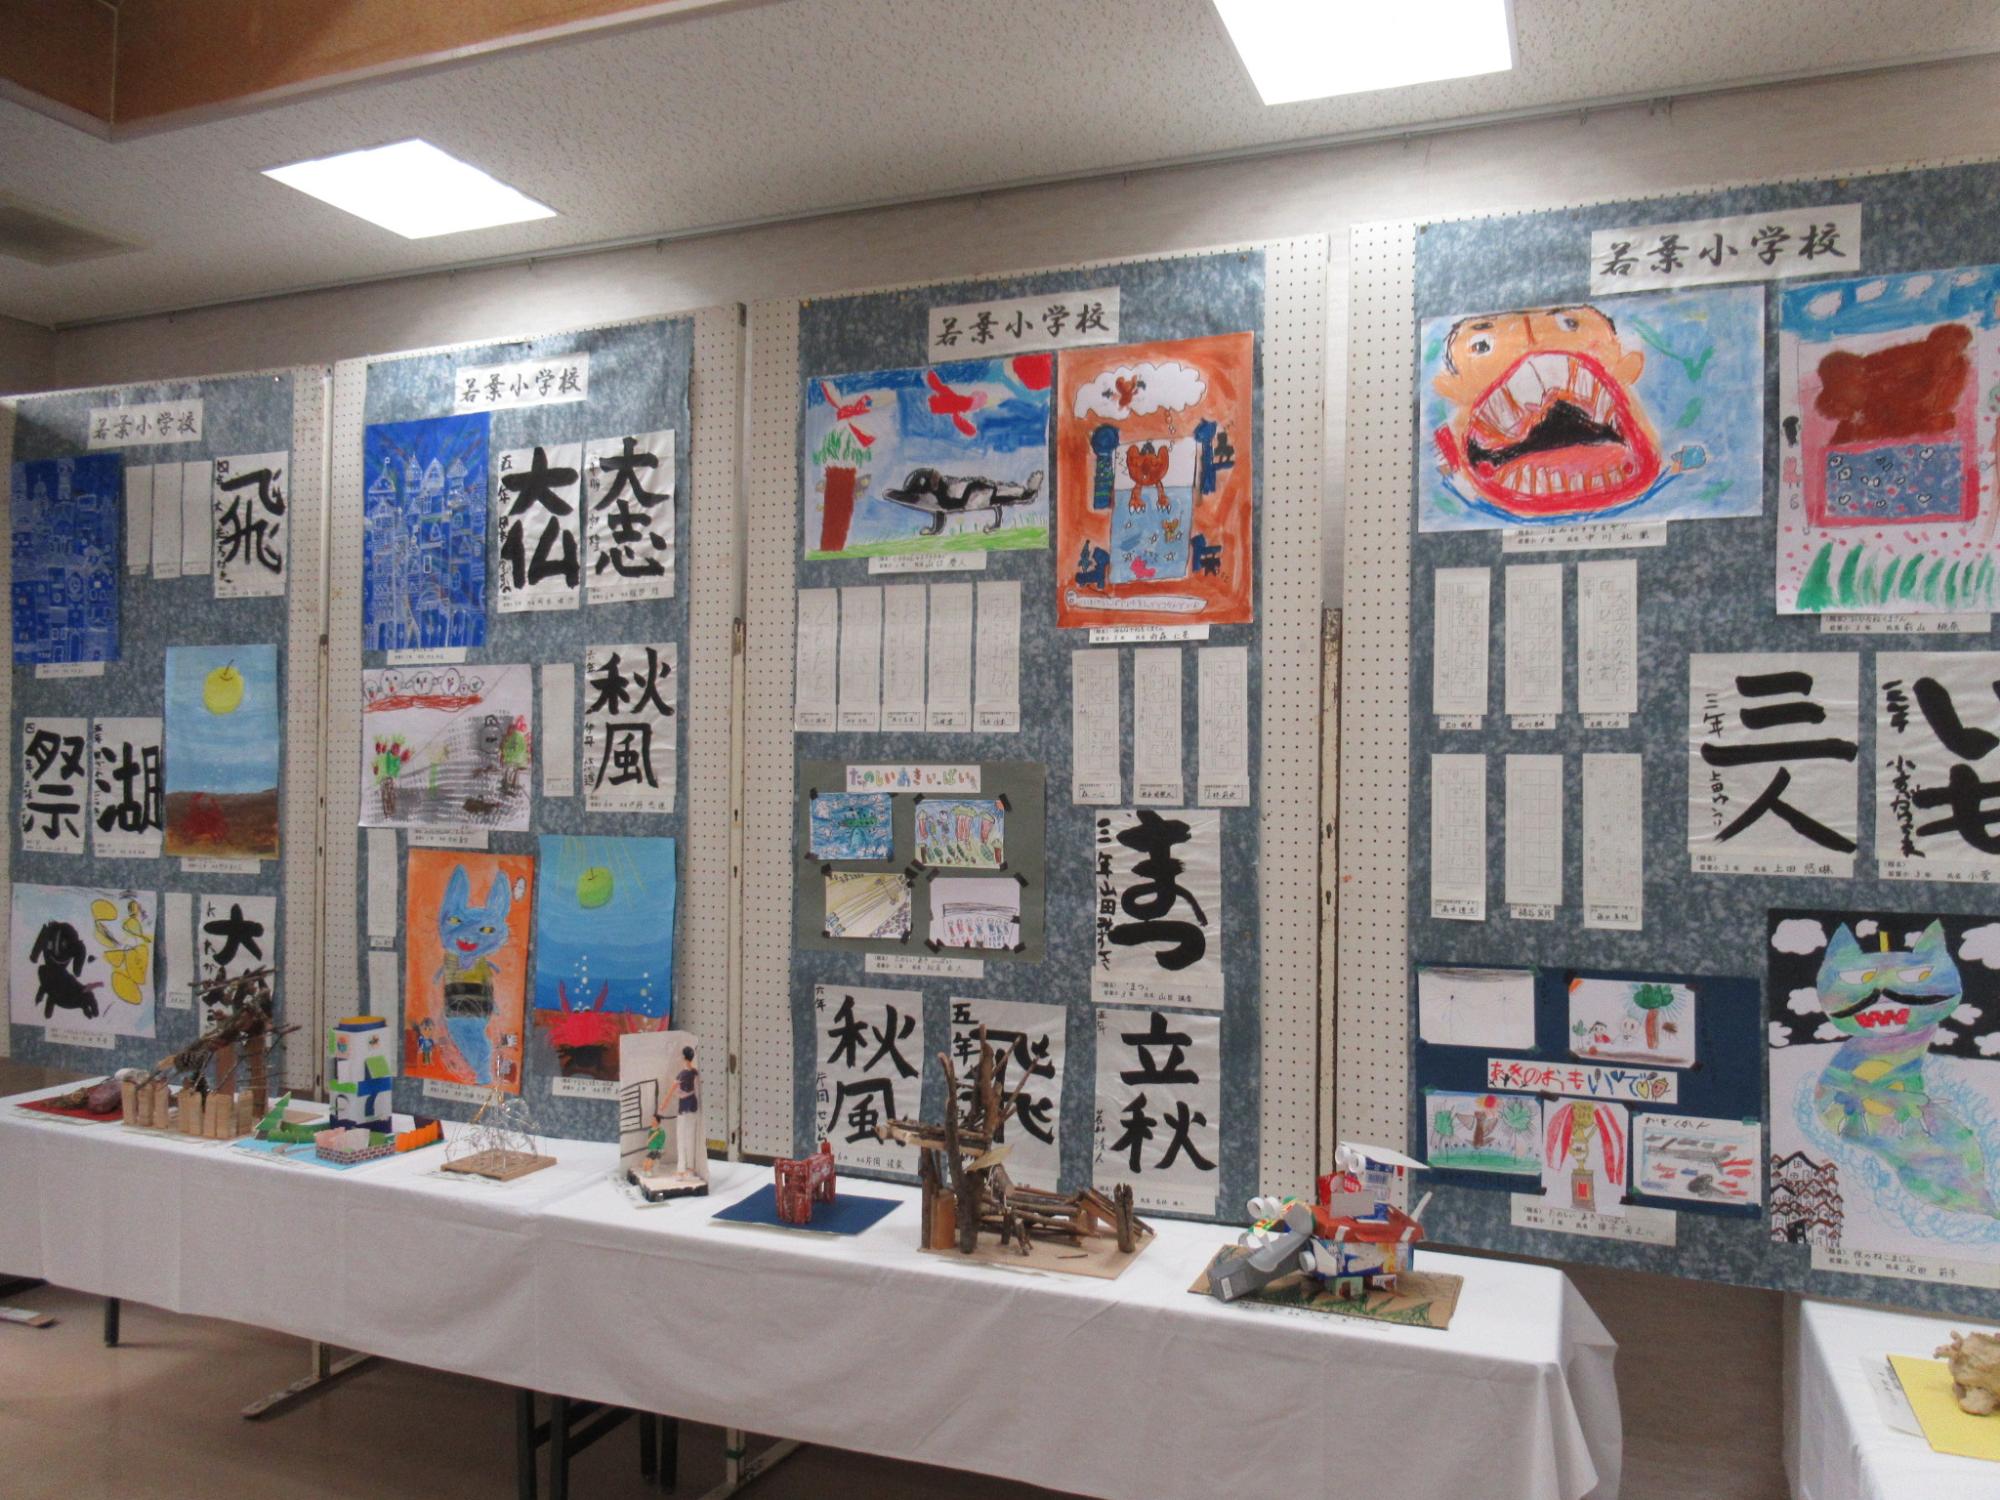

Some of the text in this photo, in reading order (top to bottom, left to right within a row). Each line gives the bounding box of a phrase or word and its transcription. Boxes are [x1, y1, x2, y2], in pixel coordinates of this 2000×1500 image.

[1600, 223, 1847, 278] 若葉小学校
[934, 303, 1110, 347] 若葉小学校
[93, 412, 197, 440] 若葉小学校
[460, 367, 582, 404] 若葉小学校
[219, 467, 286, 575] 飛
[501, 446, 580, 589] 大仏
[594, 436, 670, 577] 大志
[585, 646, 675, 793] 秋風
[1703, 693, 1726, 738] 三年
[24, 729, 85, 840] 祭
[96, 741, 162, 834] 湖
[1700, 671, 1859, 854] 三人
[1108, 810, 1208, 971] まつ
[1774, 863, 1796, 873] 上田
[815, 986, 826, 1012] 六年
[952, 1002, 981, 1066] 五年
[827, 995, 919, 1147] 秋風
[1110, 1011, 1218, 1174] 立秋
[1490, 1060, 1646, 1098] あきのおもいで
